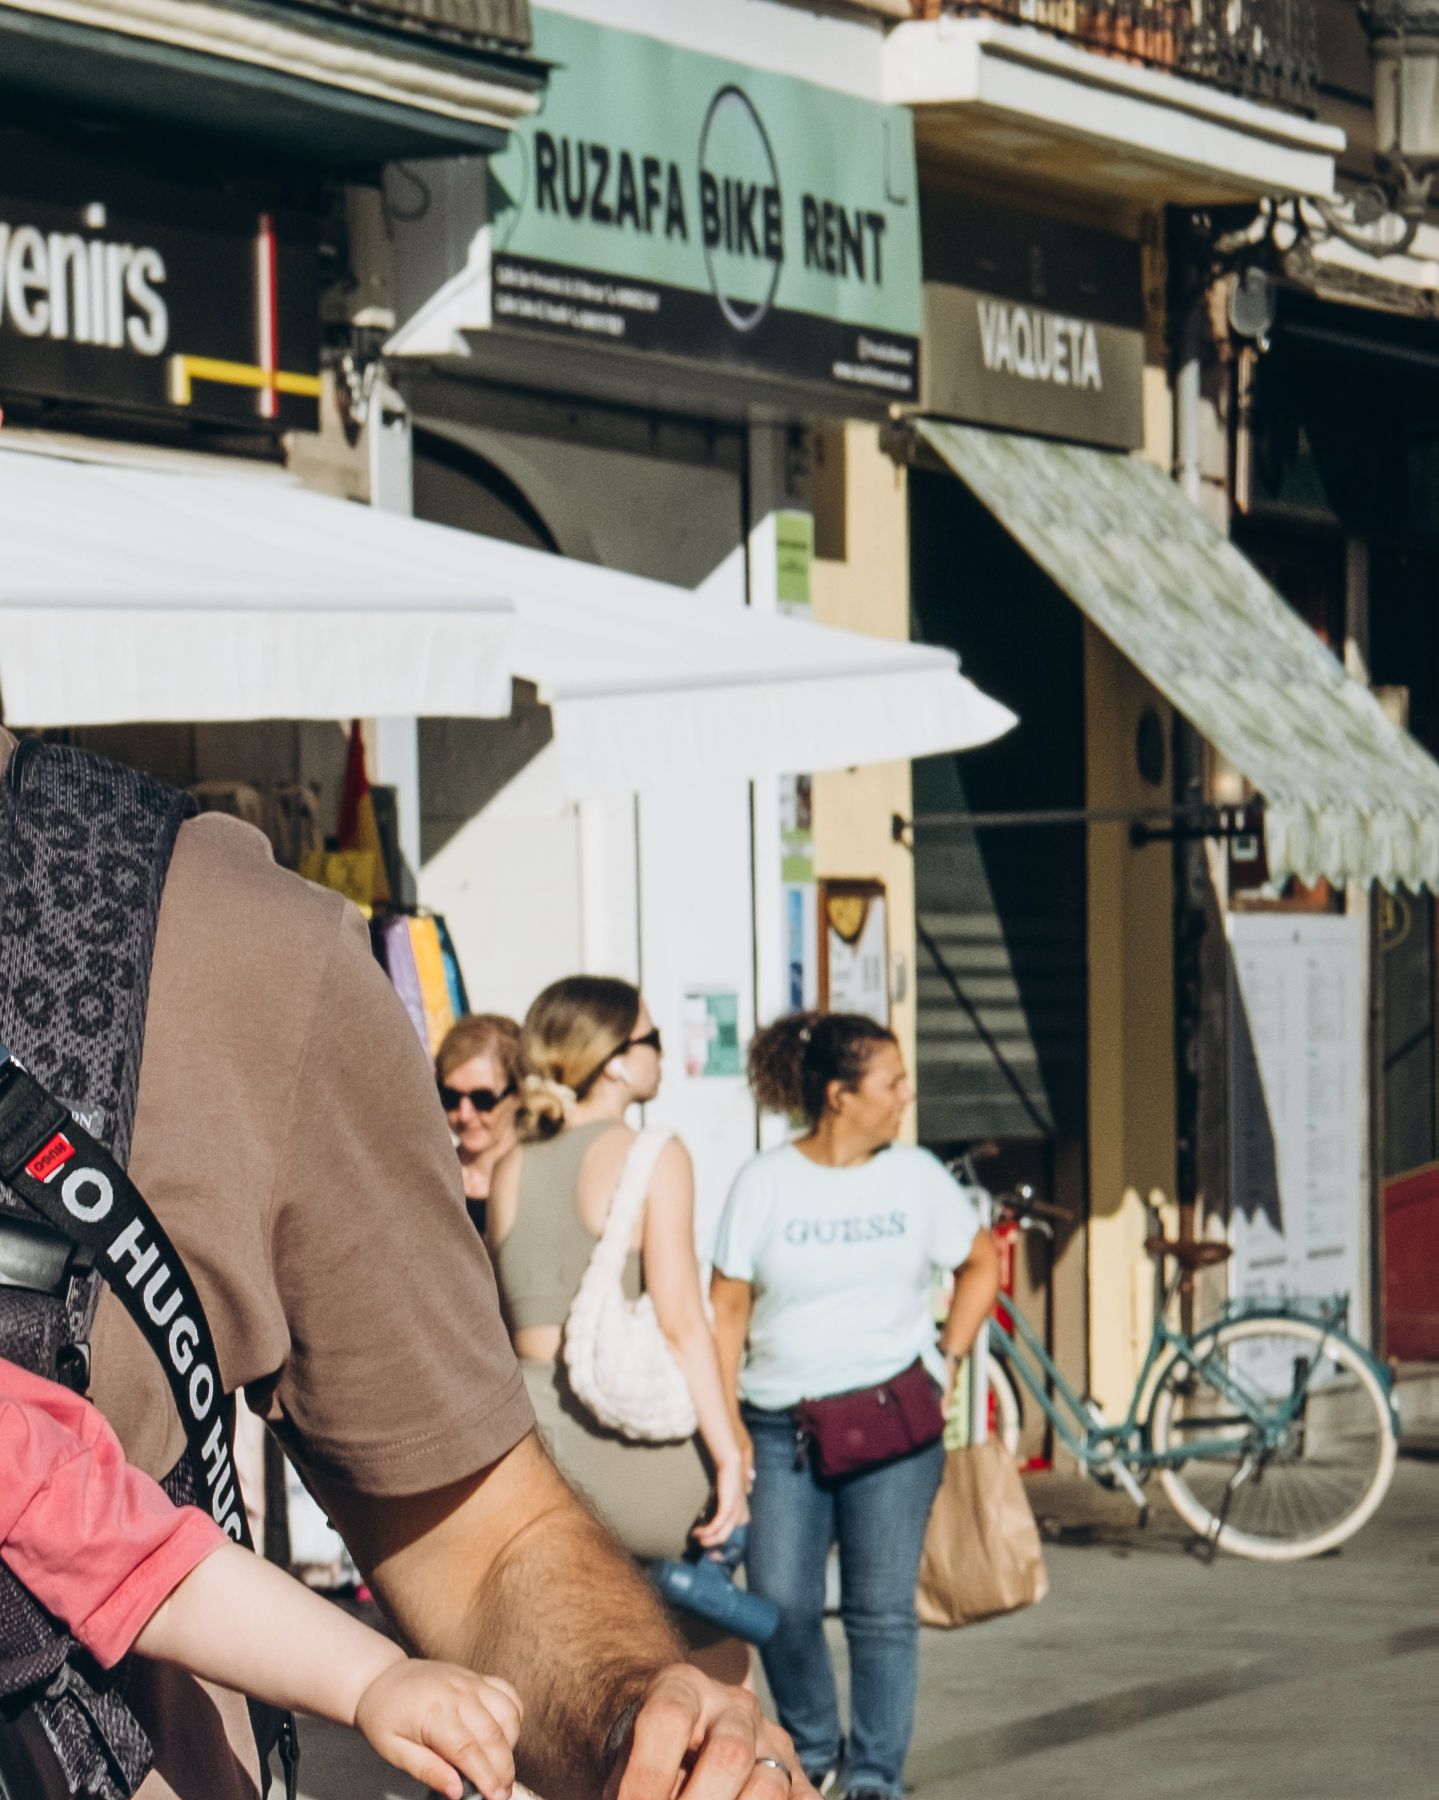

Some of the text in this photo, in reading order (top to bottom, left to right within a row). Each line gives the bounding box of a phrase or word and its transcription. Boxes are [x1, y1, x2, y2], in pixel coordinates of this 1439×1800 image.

[535, 130, 885, 287] RUZAFA BIKE RENT
[976, 298, 1104, 392] VAQUETA
[784, 1210, 907, 1246] GUESS
[107, 1216, 214, 1421] HUGO
